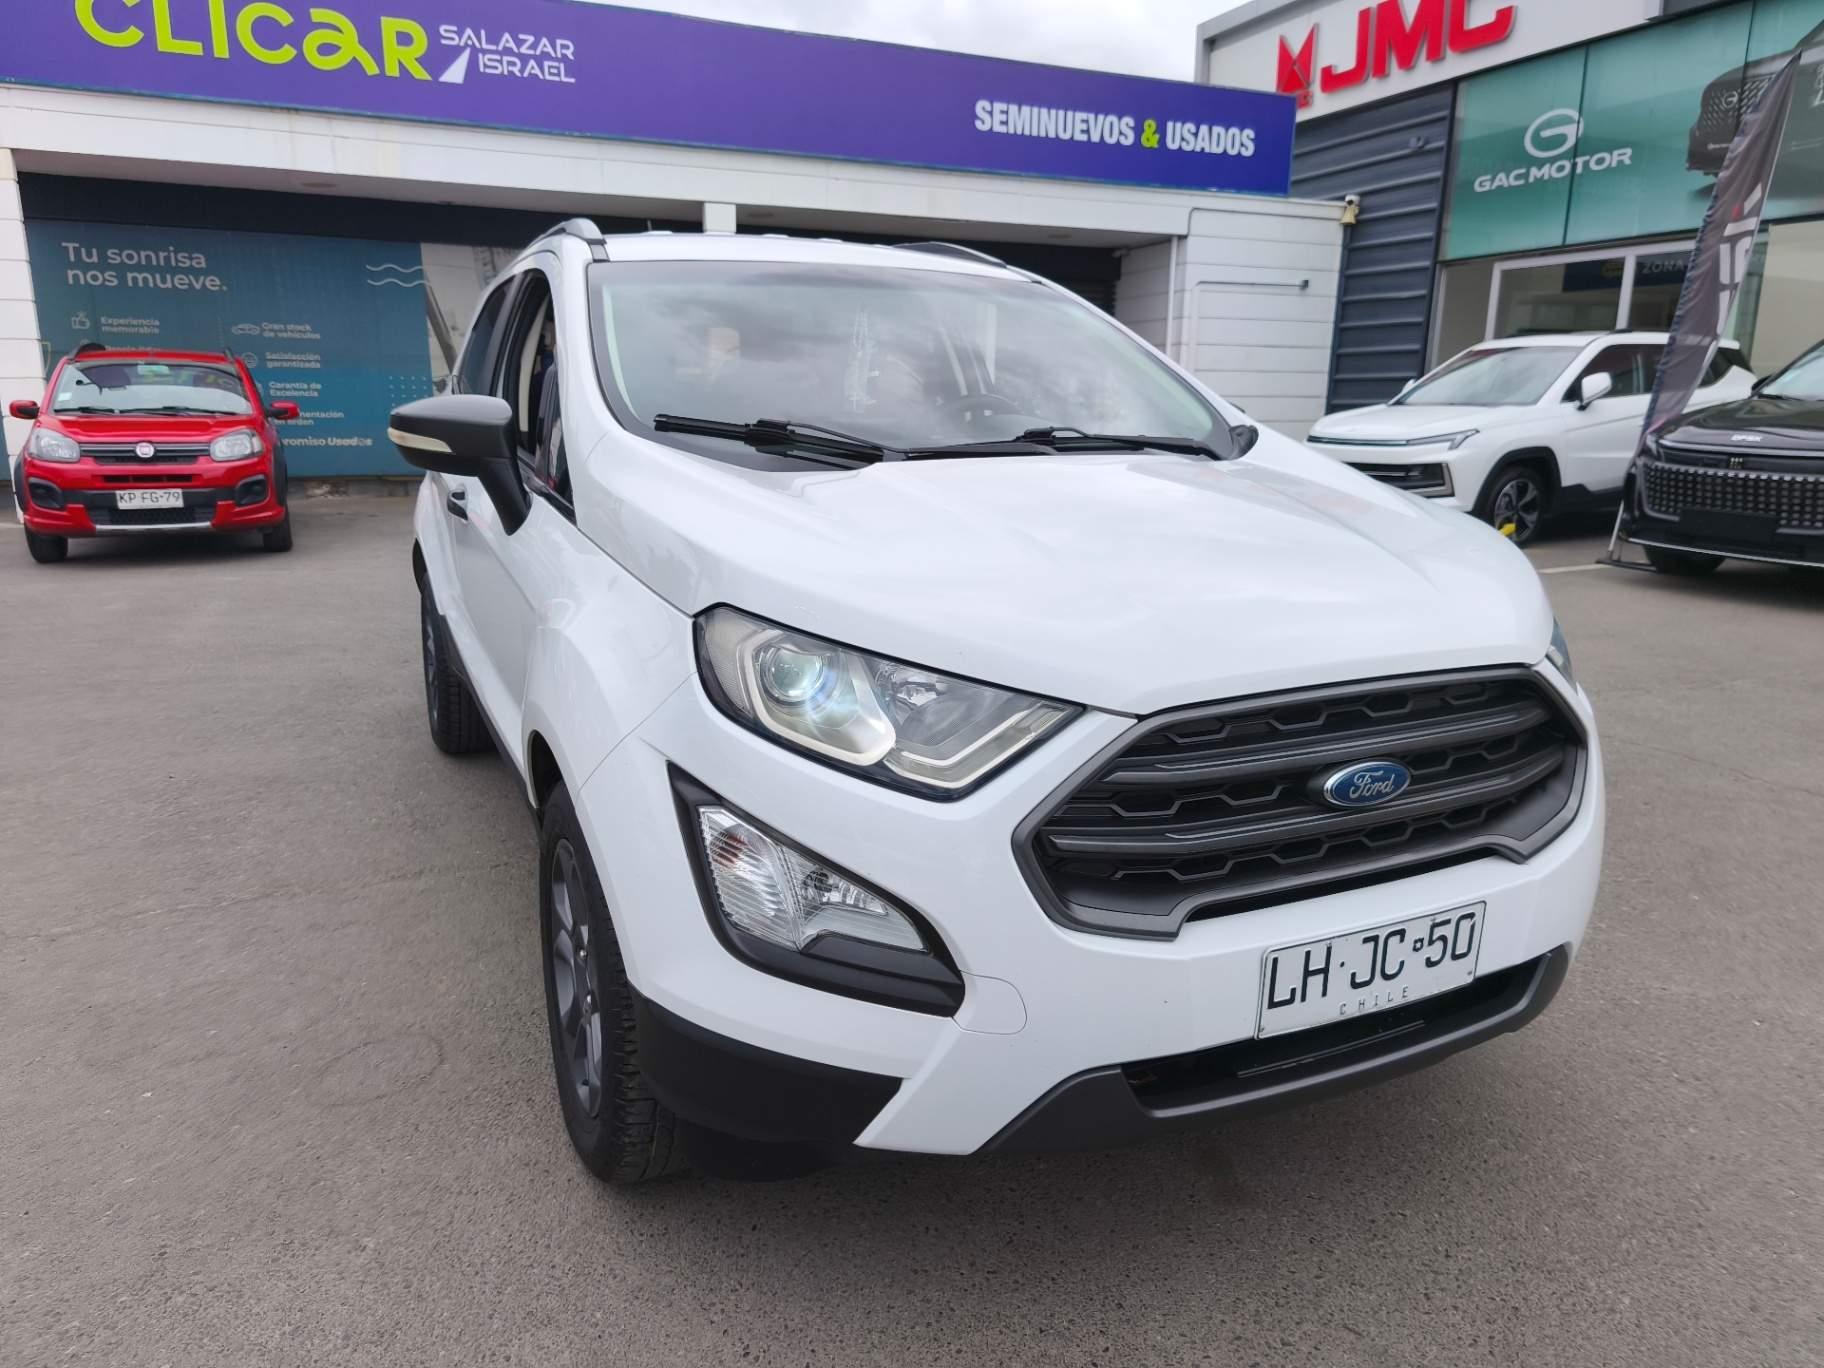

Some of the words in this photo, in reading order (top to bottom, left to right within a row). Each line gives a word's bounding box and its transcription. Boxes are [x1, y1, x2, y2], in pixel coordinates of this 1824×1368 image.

[438, 24, 576, 59] SALAZAR
[478, 54, 576, 83] ISRAEL
[975, 99, 1135, 146] SEMINUEVOS
[1141, 119, 1160, 148] &
[1166, 121, 1255, 157] USADOS
[1474, 168, 1527, 192] GAC
[1528, 147, 1633, 183] MOTOR
[62, 242, 98, 263] Tu
[107, 246, 207, 268] sonrisa
[67, 269, 119, 286] nos
[126, 271, 227, 291] mueve.
[1349, 770, 1395, 799] Ford
[1339, 986, 1409, 1015] CHILE
